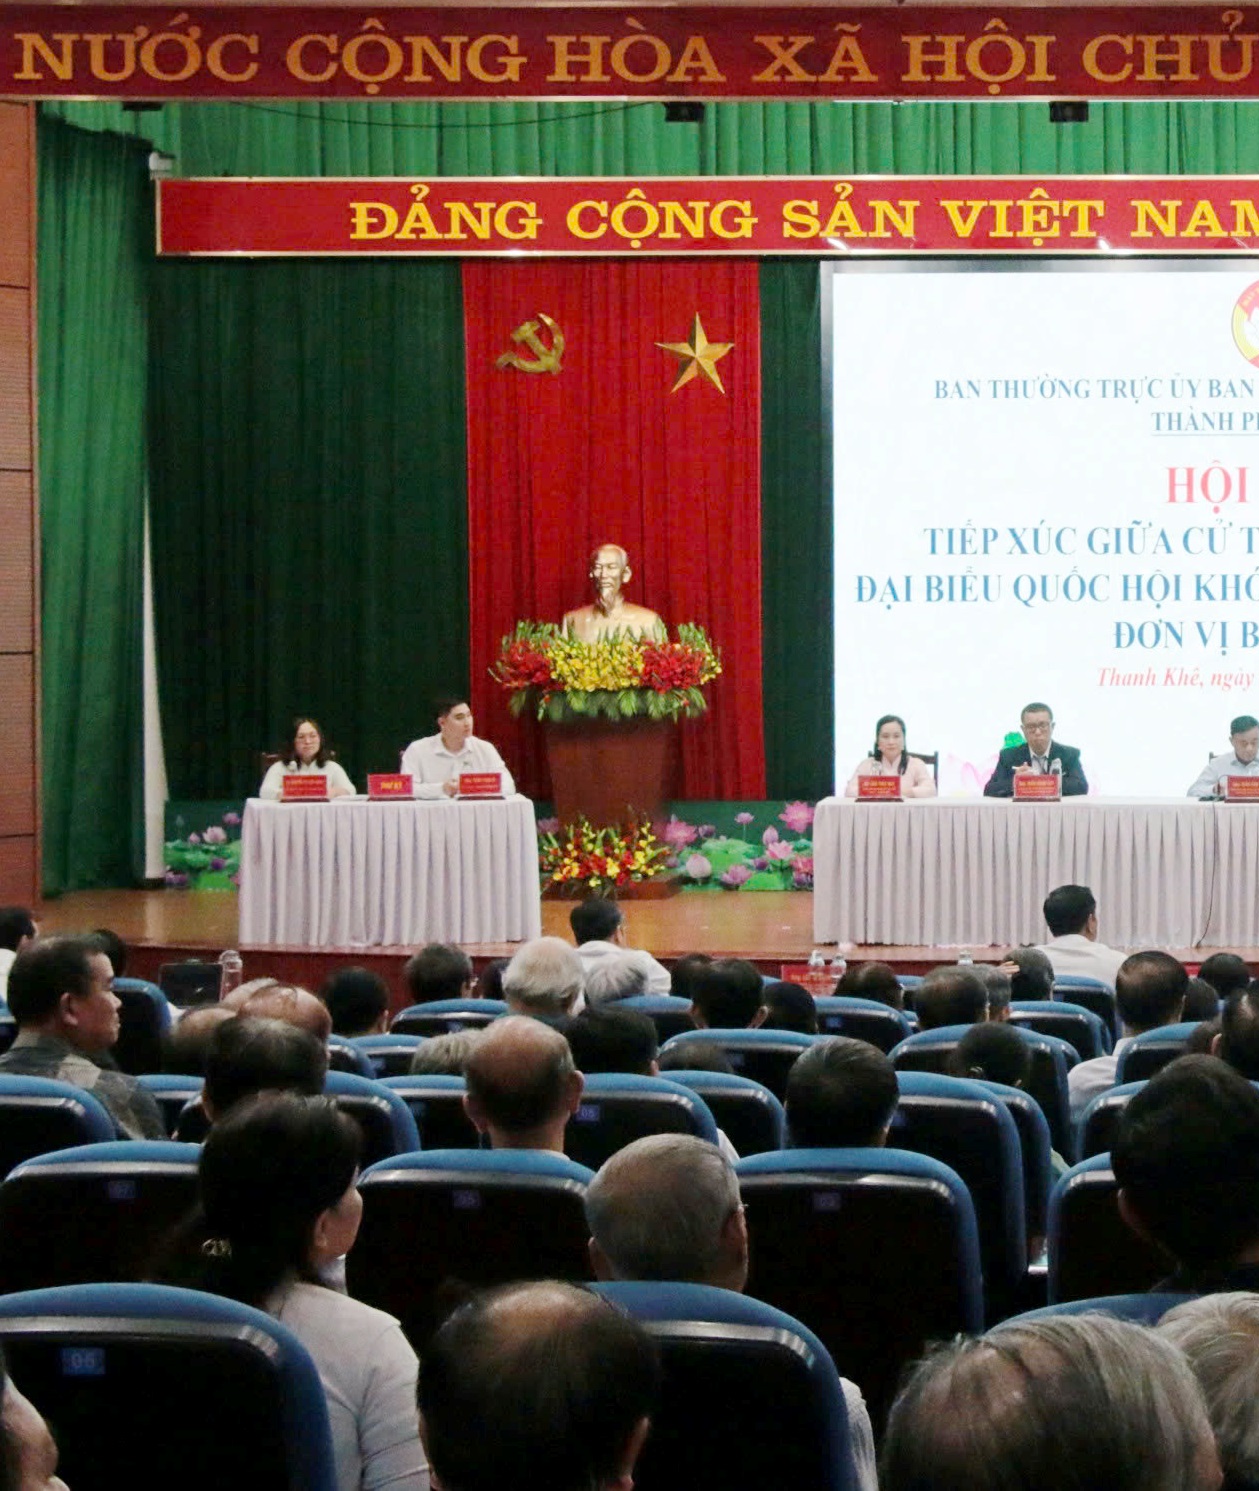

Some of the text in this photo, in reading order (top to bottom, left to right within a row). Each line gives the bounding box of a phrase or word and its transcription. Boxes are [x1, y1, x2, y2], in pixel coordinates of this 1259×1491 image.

[14, 17, 257, 82] NƯỚC
[287, 19, 527, 94] CỘNG
[547, 18, 726, 82] HÒA
[753, 24, 878, 81] XÃ
[902, 19, 1054, 94] HỘI
[1083, 11, 1258, 82] CHỦ
[350, 184, 543, 239] ĐẢNG
[566, 188, 758, 247] CỘNG
[783, 184, 917, 238] SẢN
[940, 187, 1105, 246] VIỆT
[935, 380, 980, 399] BAN
[988, 374, 1090, 399] THƯỜNG
[1097, 376, 1162, 404] TRỰC
[1170, 373, 1199, 398] ỦY
[1208, 379, 1253, 398] BAN
[1151, 406, 1234, 431] THÀNH
[1168, 460, 1247, 514] HỘI
[923, 519, 999, 555] TIẾP
[1007, 519, 1076, 555] XÚC
[1087, 520, 1173, 555] GIỮA
[1182, 519, 1233, 554] CỬ
[855, 575, 912, 610] ĐẠI
[925, 566, 1001, 603] BIỂU
[1013, 566, 1110, 608] QUỐC
[1122, 569, 1182, 610] HỘI
[1113, 618, 1184, 649] ĐƠN
[1195, 621, 1228, 656] VỊ
[1099, 668, 1157, 687] Thanh
[1164, 668, 1203, 687] Khê,
[1211, 672, 1252, 691] ngày
